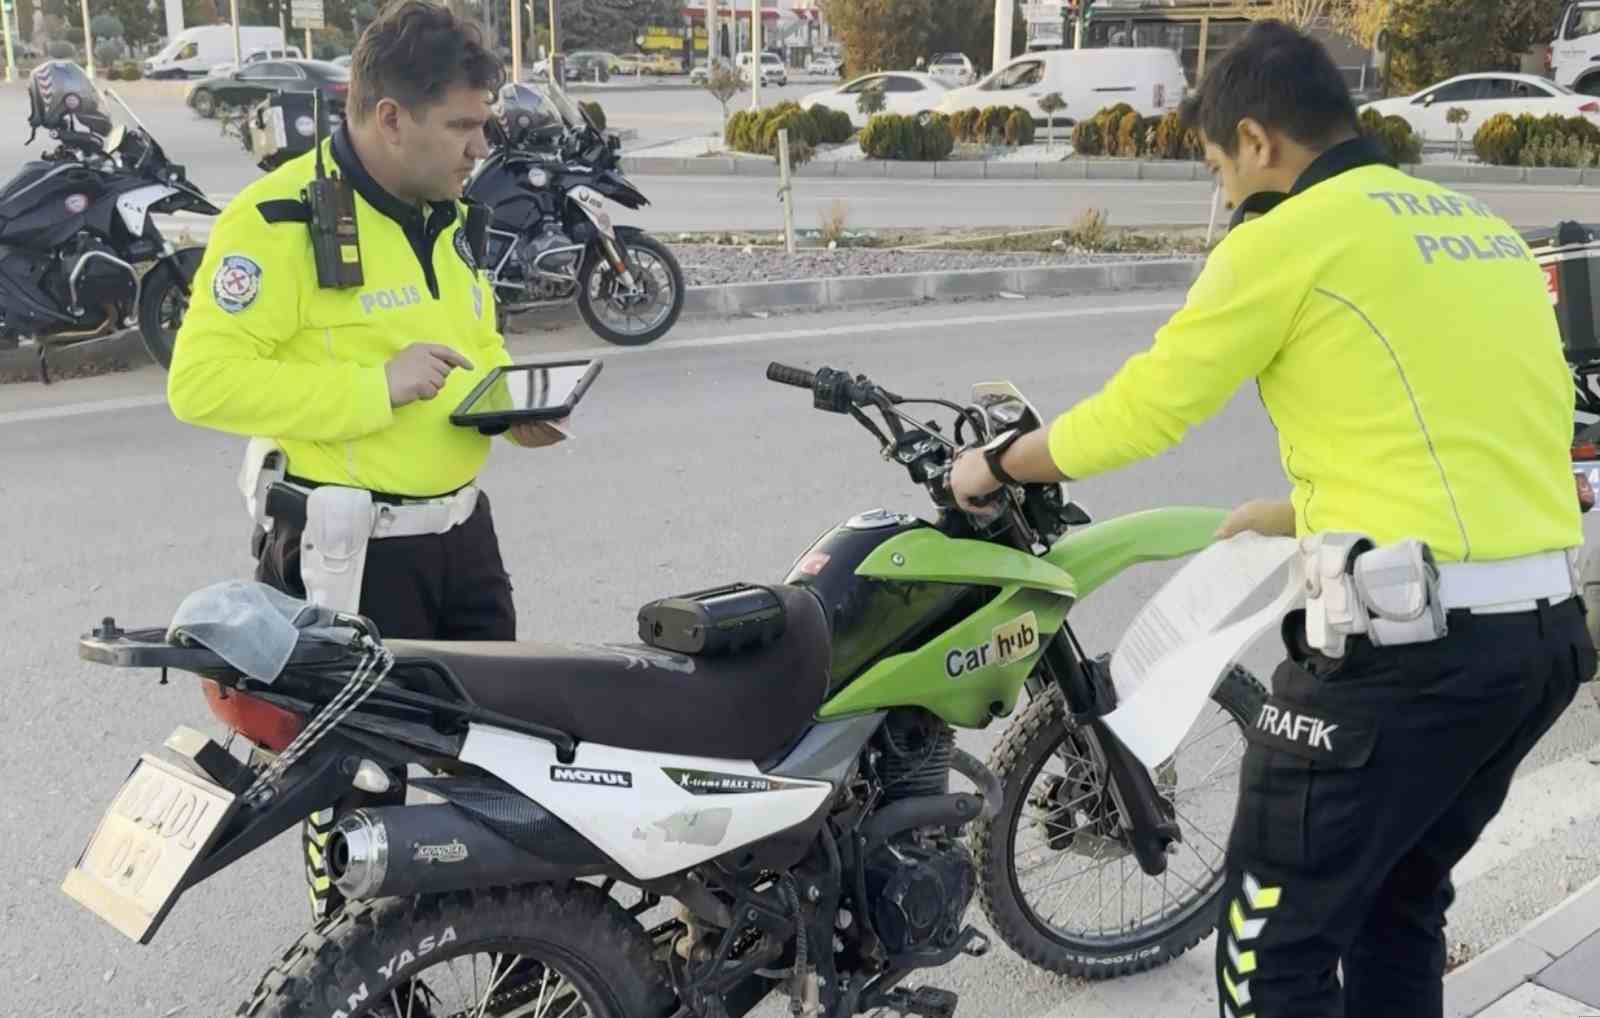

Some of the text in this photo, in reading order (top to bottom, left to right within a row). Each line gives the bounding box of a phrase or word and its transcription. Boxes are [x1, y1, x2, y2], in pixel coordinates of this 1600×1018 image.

[946, 624, 1034, 678] Car hub
[554, 768, 629, 786] MOTUL
[377, 925, 457, 979] YASA
